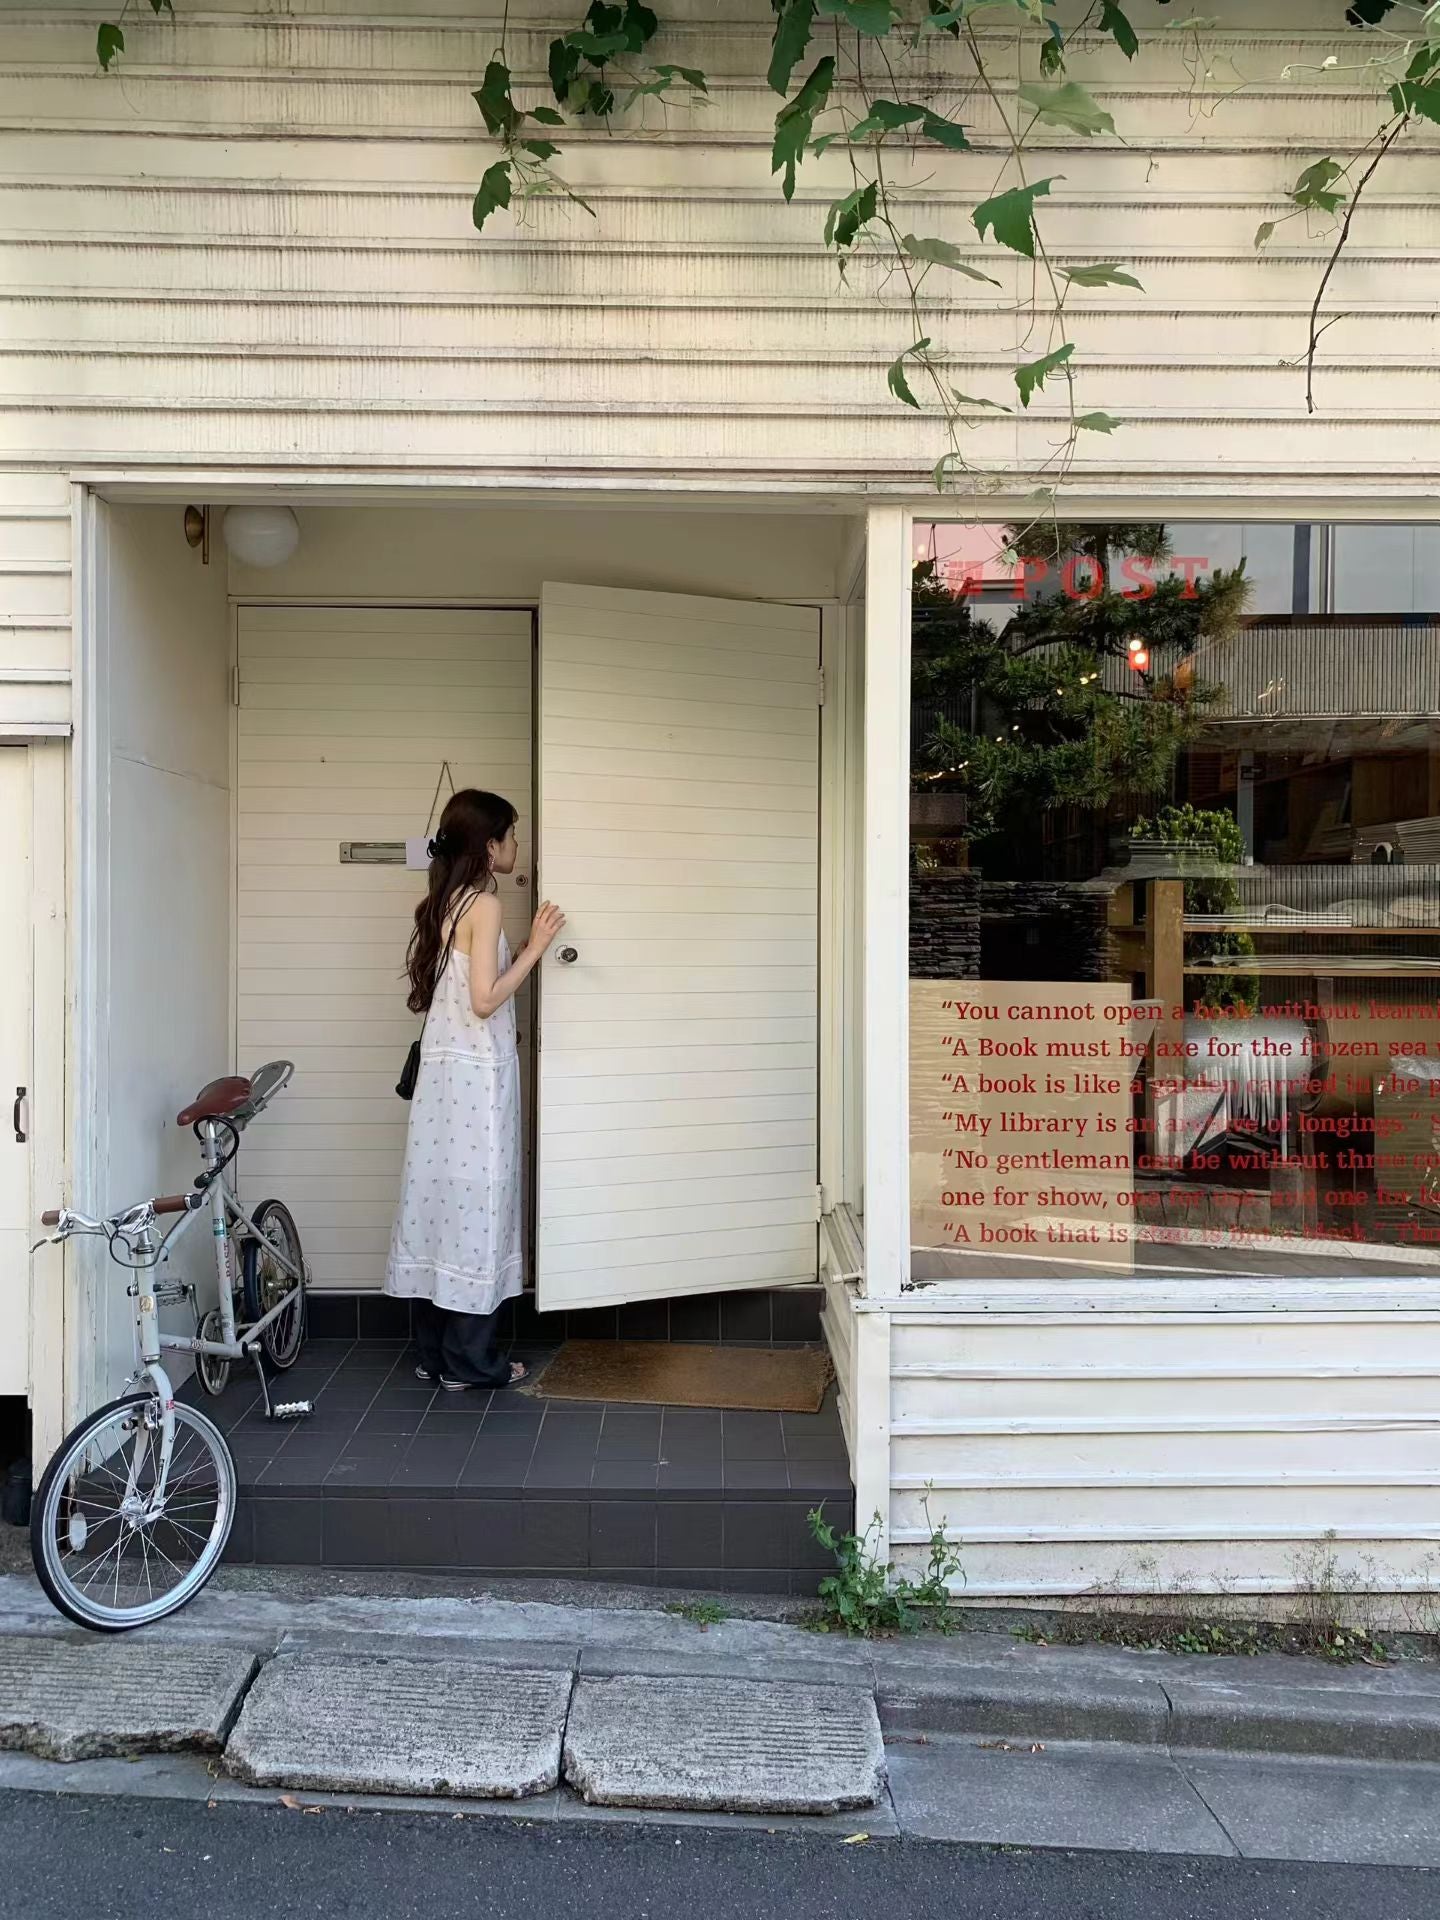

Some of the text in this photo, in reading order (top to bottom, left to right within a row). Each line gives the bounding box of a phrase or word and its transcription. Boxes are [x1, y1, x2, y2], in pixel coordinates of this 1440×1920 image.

[1009, 556, 1208, 601] POST
[942, 1001, 1000, 1020] “You
[1007, 1002, 1095, 1020] cannot
[1103, 1005, 1163, 1025] open
[1171, 1005, 1186, 1020] a
[1193, 999, 1256, 1020] book
[1262, 999, 1361, 1020] without
[941, 1037, 970, 1056] “A
[978, 1036, 1038, 1057] Book
[1046, 1039, 1110, 1057] must
[1119, 1037, 1149, 1057] be
[1156, 1041, 1199, 1057] axe
[1207, 1037, 1242, 1056] for
[1251, 1037, 1292, 1057] the
[1300, 1036, 1379, 1057] frozen
[1389, 1041, 1427, 1056] sea
[941, 1073, 970, 1093] “A
[978, 1073, 1037, 1093] book
[1044, 1073, 1066, 1093] is
[1074, 1073, 1121, 1094] like
[1129, 1079, 1145, 1094] a
[1247, 1072, 1338, 1095] carried
[1346, 1073, 1372, 1095] in
[1380, 1072, 1420, 1093] the
[942, 1112, 992, 1137] “My
[1000, 1112, 1088, 1138] library
[1096, 1112, 1117, 1132] is
[1125, 1118, 1156, 1133] an
[1267, 1112, 1292, 1132] of
[942, 1149, 988, 1169] “No
[996, 1149, 1130, 1174] gentleman
[1138, 1154, 1183, 1170] can
[1191, 1149, 1221, 1170] be
[1228, 1149, 1329, 1170] without
[1337, 1149, 1407, 1169] three
[941, 1191, 985, 1206] one
[994, 1186, 1029, 1206] for
[1037, 1186, 1107, 1209] show,
[1116, 1191, 1160, 1206] one
[1169, 1186, 1206, 1206] for
[1324, 1190, 1369, 1206] one
[1377, 1185, 1411, 1206] for
[944, 1223, 971, 1243] “A
[979, 1223, 1038, 1243] book
[1047, 1224, 1100, 1243] that
[1108, 1223, 1128, 1243] is
